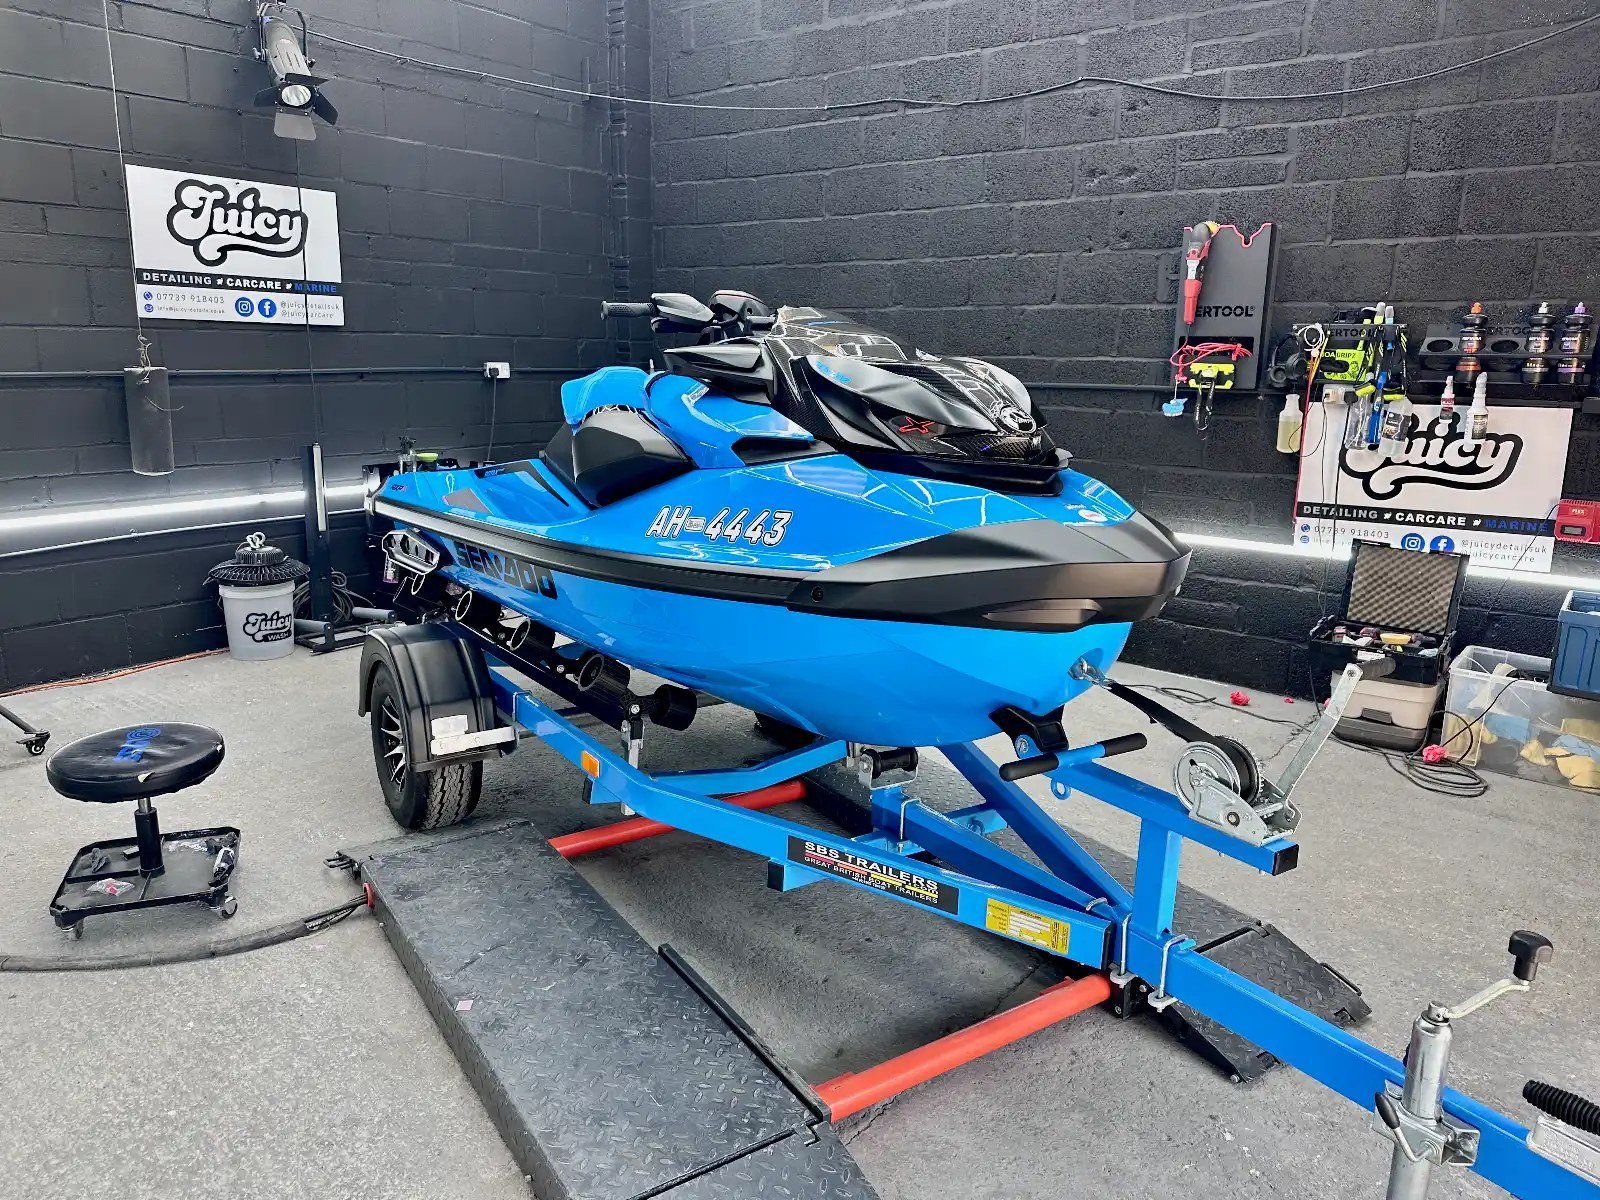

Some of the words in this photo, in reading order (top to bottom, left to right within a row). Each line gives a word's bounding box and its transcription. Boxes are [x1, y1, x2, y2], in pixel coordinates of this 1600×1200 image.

[168, 179, 308, 266] Juicy
[142, 272, 212, 285] DETAILING
[226, 277, 282, 290] CARCARE
[294, 282, 337, 293] MARINE
[156, 292, 186, 302] 07739
[190, 294, 225, 304] 918403
[1303, 505, 1378, 519] DETAILING
[1395, 512, 1468, 527] CARCARE
[1484, 518, 1549, 533] MARINE
[1314, 525, 1346, 535] 07739
[1350, 528, 1389, 539] 918403
[243, 611, 292, 642] Juicy
[804, 856, 831, 869] GREAT
[833, 865, 870, 880] BRITISH
[868, 876, 891, 889] BOAT
[894, 884, 938, 904] TRAILERS
[805, 841, 839, 859] SBS
[845, 854, 938, 890] TRAILERS
